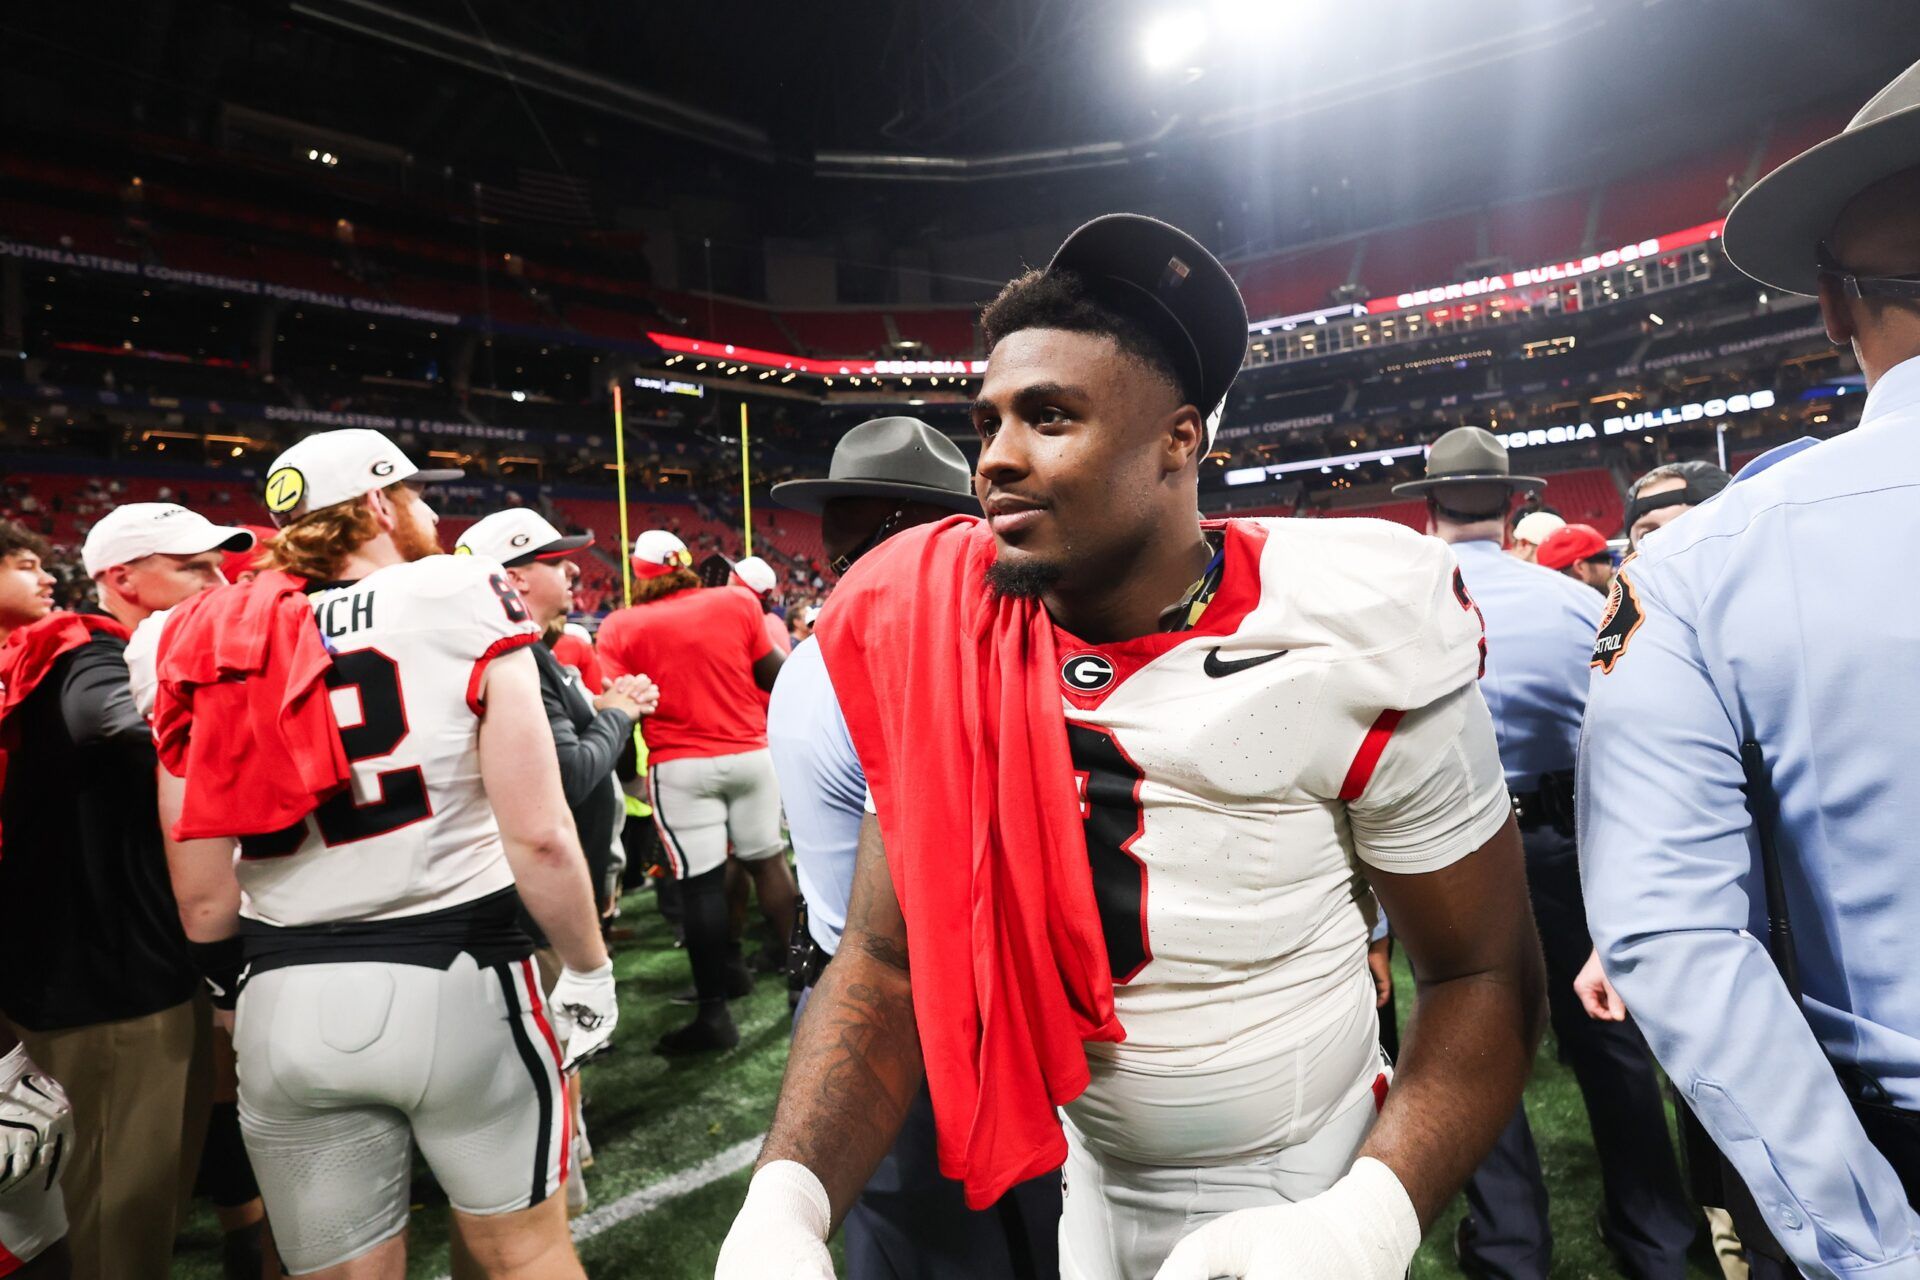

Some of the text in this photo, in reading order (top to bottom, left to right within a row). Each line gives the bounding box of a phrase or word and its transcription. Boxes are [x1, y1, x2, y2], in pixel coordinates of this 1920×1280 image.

[0, 241, 138, 273] OUTHEASTERN
[1397, 238, 1660, 308] GEORGIA BULLDOGS
[874, 360, 967, 374] GEORGIA
[264, 405, 527, 442] SOUTHEASTERN CONFERENCE
[1495, 389, 1775, 450] EORGIA BULLDOGS
[1062, 655, 1113, 690] G
